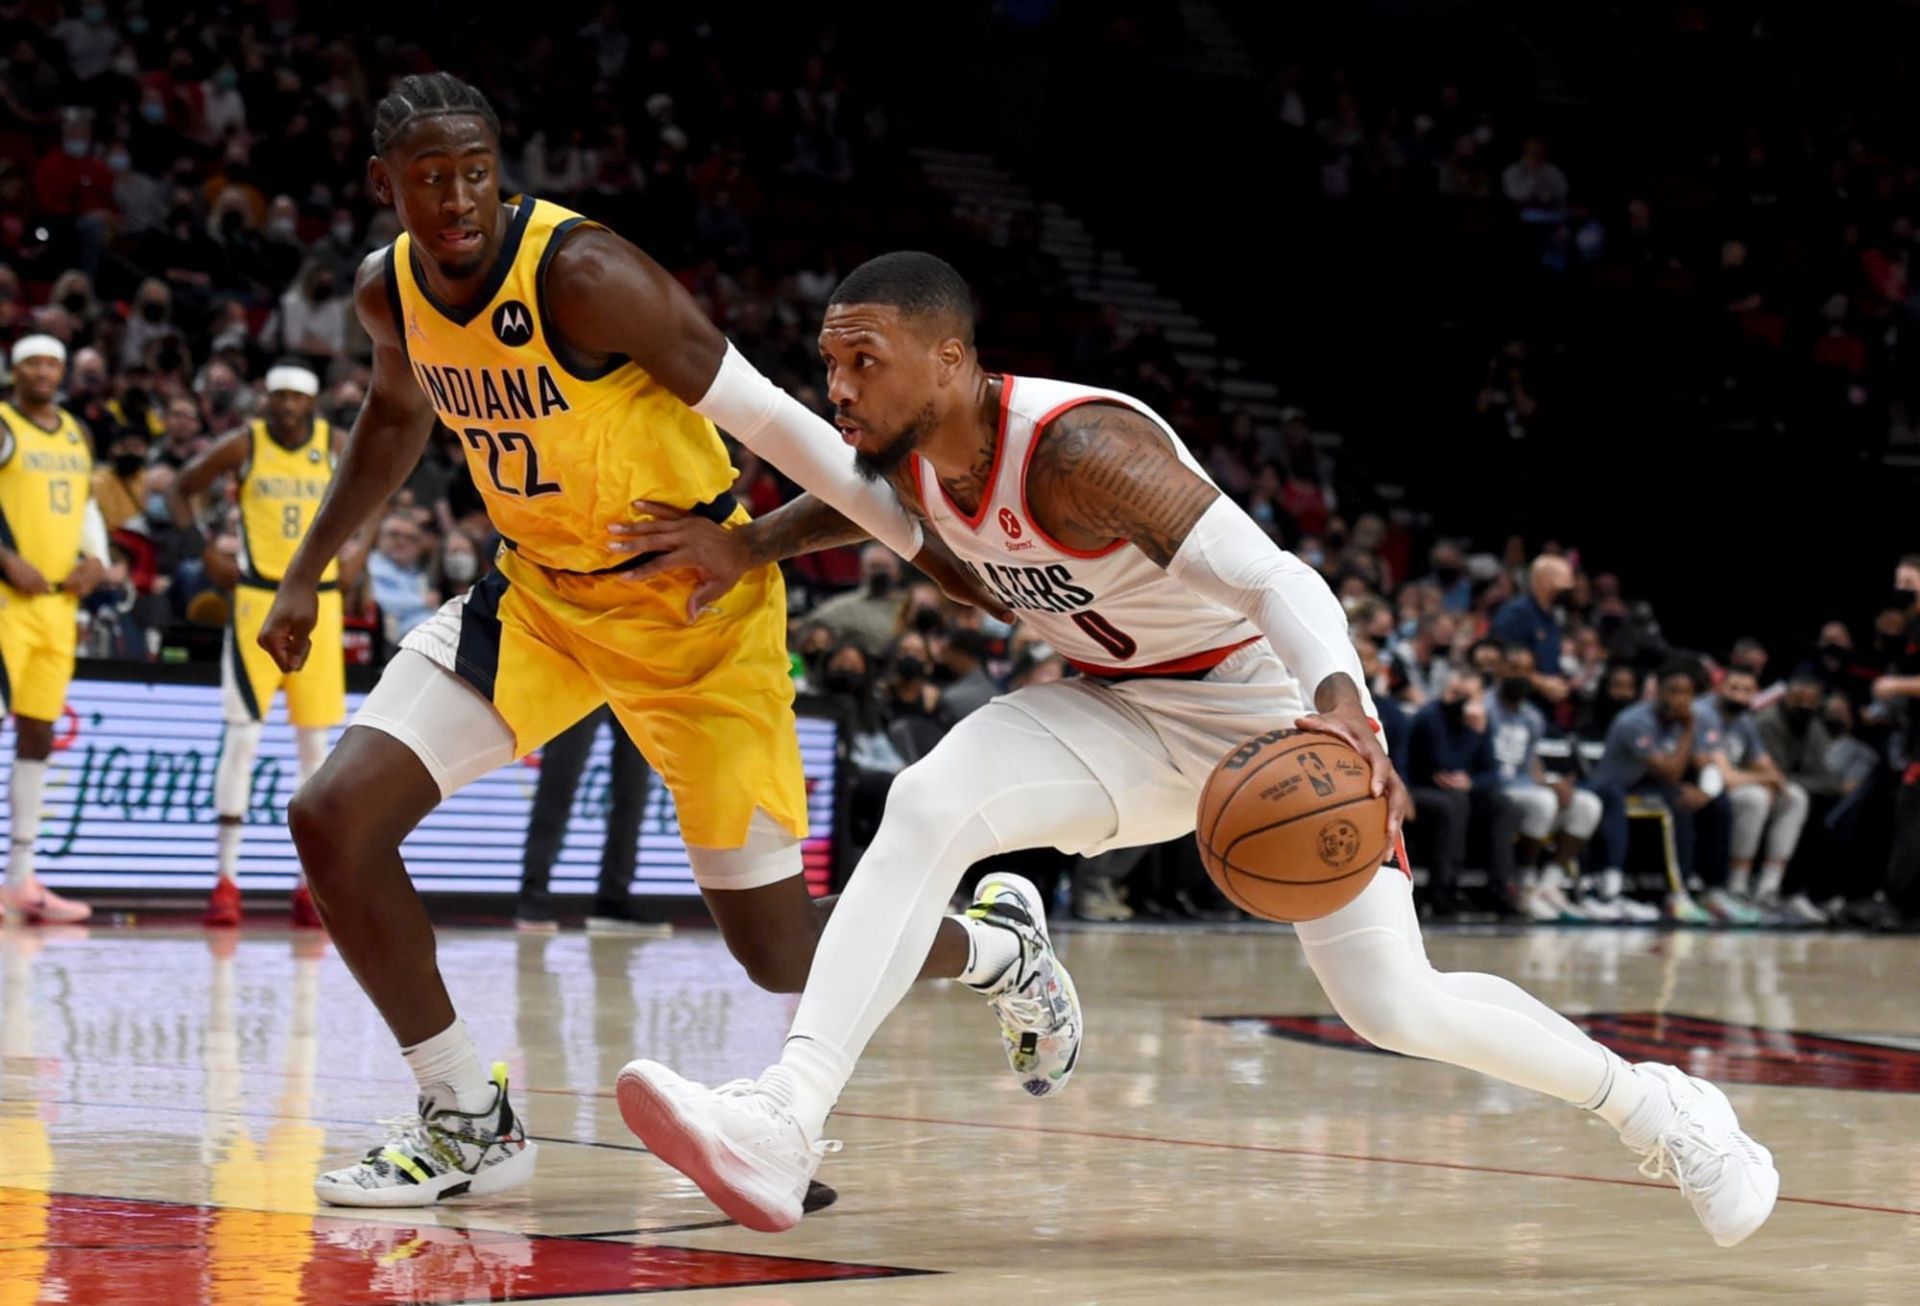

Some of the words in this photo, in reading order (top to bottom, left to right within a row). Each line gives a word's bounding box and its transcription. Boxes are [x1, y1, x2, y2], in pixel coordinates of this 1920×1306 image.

[413, 360, 570, 420] INDIANA
[453, 428, 563, 498] 22
[49, 480, 72, 515] 13
[283, 505, 300, 539] 8
[966, 559, 1095, 613] LAZERS
[1071, 609, 1137, 661] 0
[40, 711, 284, 858] jama
